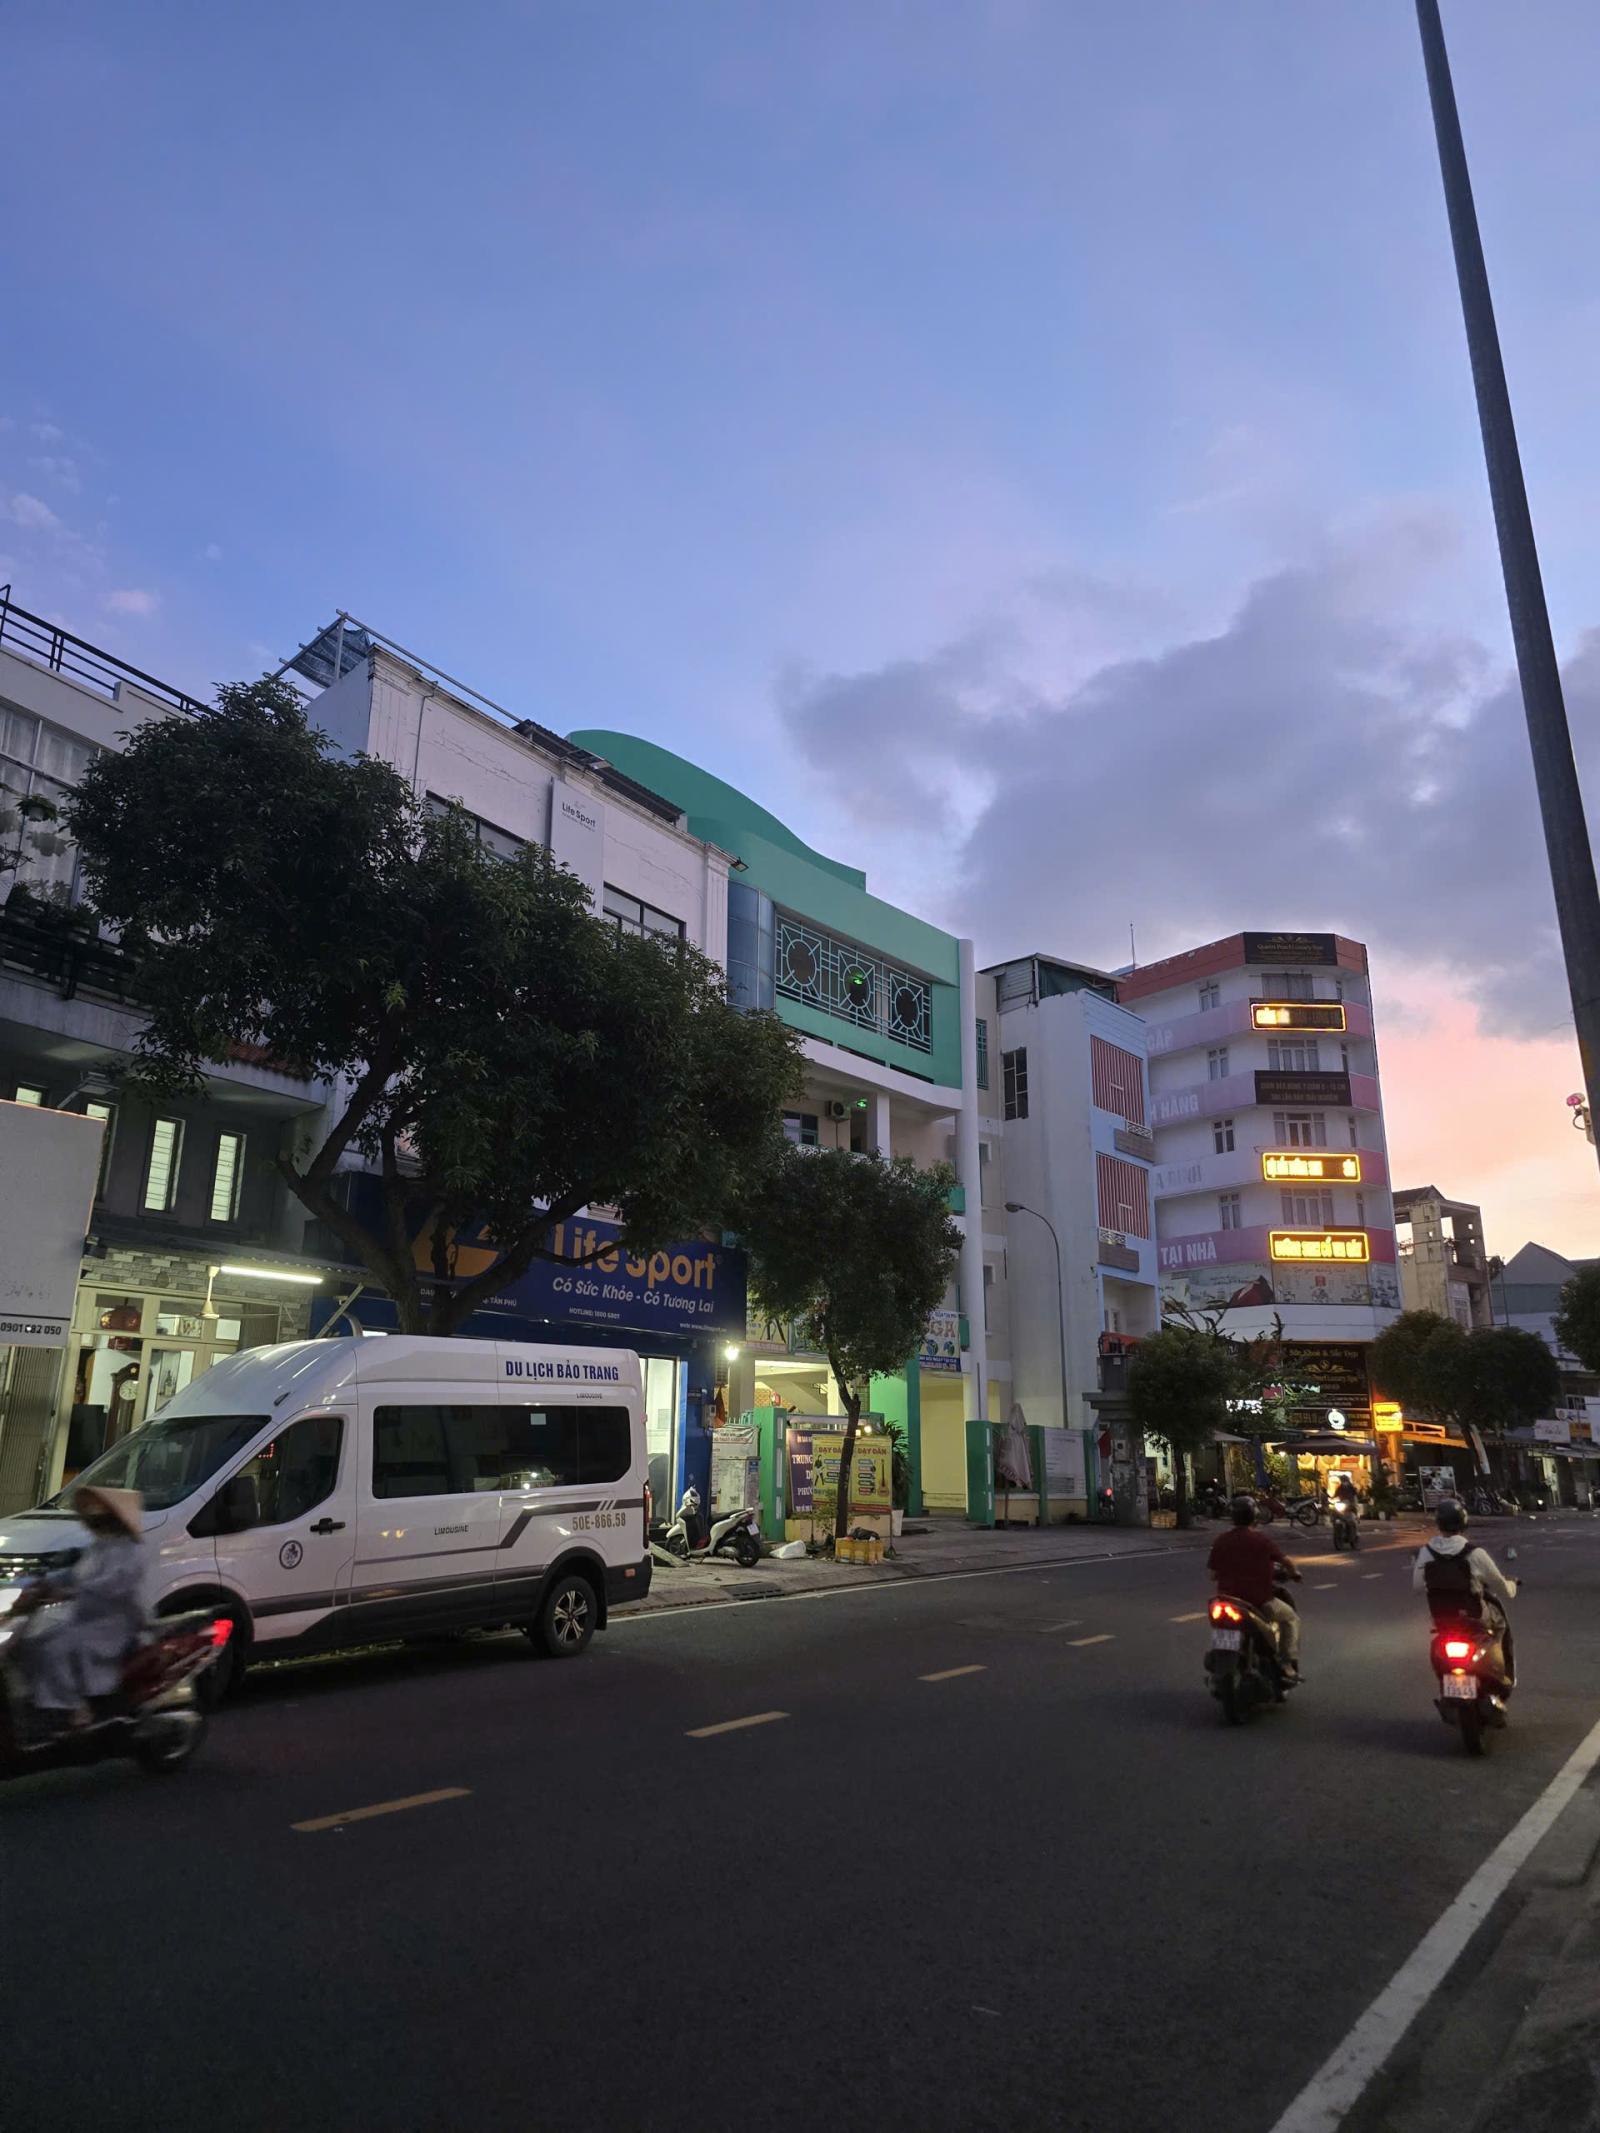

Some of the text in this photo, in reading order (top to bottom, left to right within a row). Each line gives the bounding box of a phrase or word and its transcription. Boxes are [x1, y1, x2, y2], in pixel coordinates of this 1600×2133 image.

[562, 802, 596, 827] Life Sport
[1160, 1237, 1217, 1268] TẠI NHÀ
[552, 1277, 573, 1293] Có
[575, 1279, 599, 1297] Sức
[643, 1290, 660, 1305] Có
[663, 1293, 696, 1314] Tương
[698, 1298, 714, 1313] Lai
[1, 1322, 23, 1333] 0901
[44, 1325, 62, 1335] 050
[505, 1360, 619, 1381] DU LỊCH BẢO TRANG
[791, 1454, 813, 1464] TRUNG
[434, 1525, 469, 1536] LIMOUSINE
[572, 1512, 626, 1531] 50E-866.58
